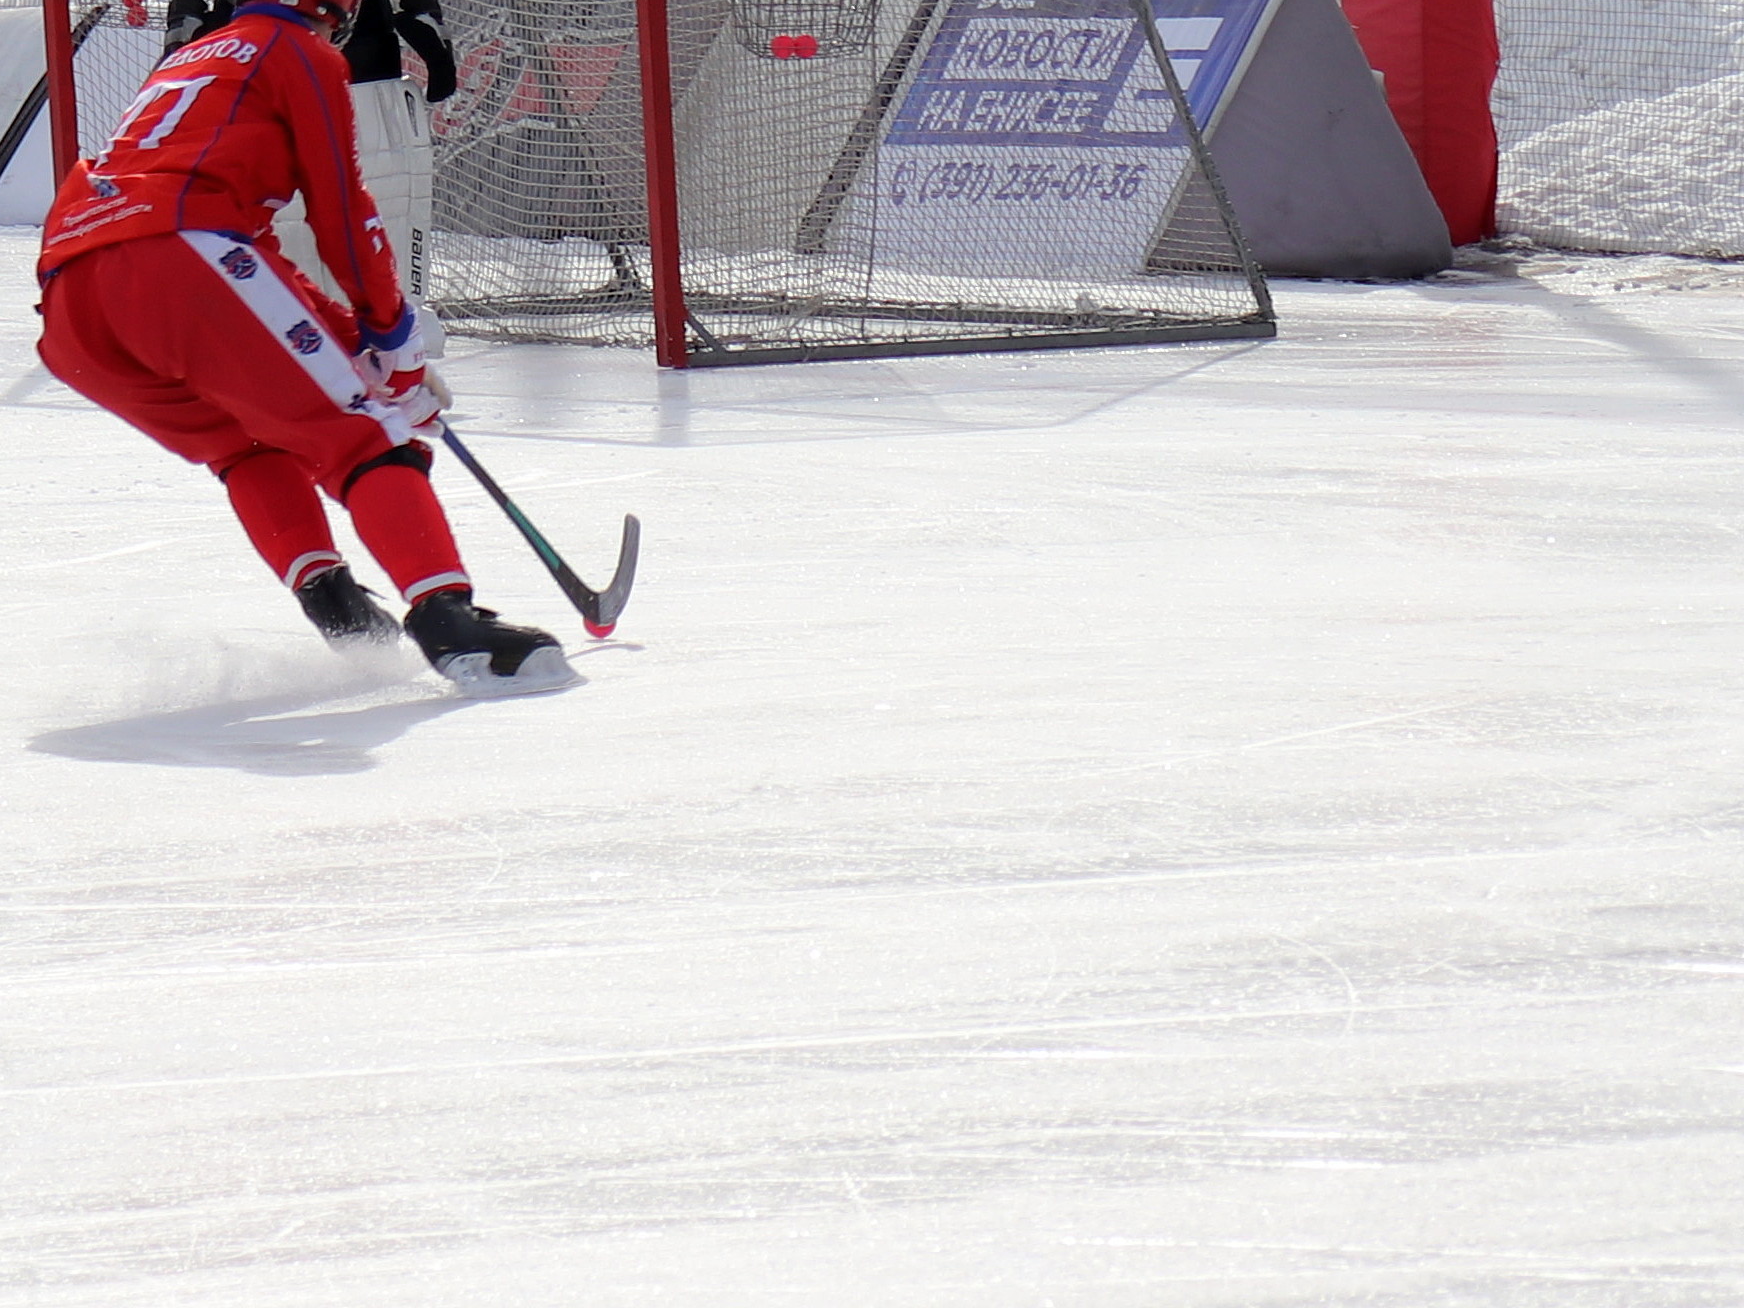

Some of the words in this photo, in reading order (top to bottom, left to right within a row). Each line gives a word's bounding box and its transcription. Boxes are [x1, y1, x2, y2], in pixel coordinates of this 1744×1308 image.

[953, 29, 1123, 70] НОВОСТИ
[916, 90, 966, 132] НА
[964, 90, 1100, 133] ЕНИСЕЕ
[920, 163, 995, 204] (391)
[997, 164, 1148, 200] 236-01-36
